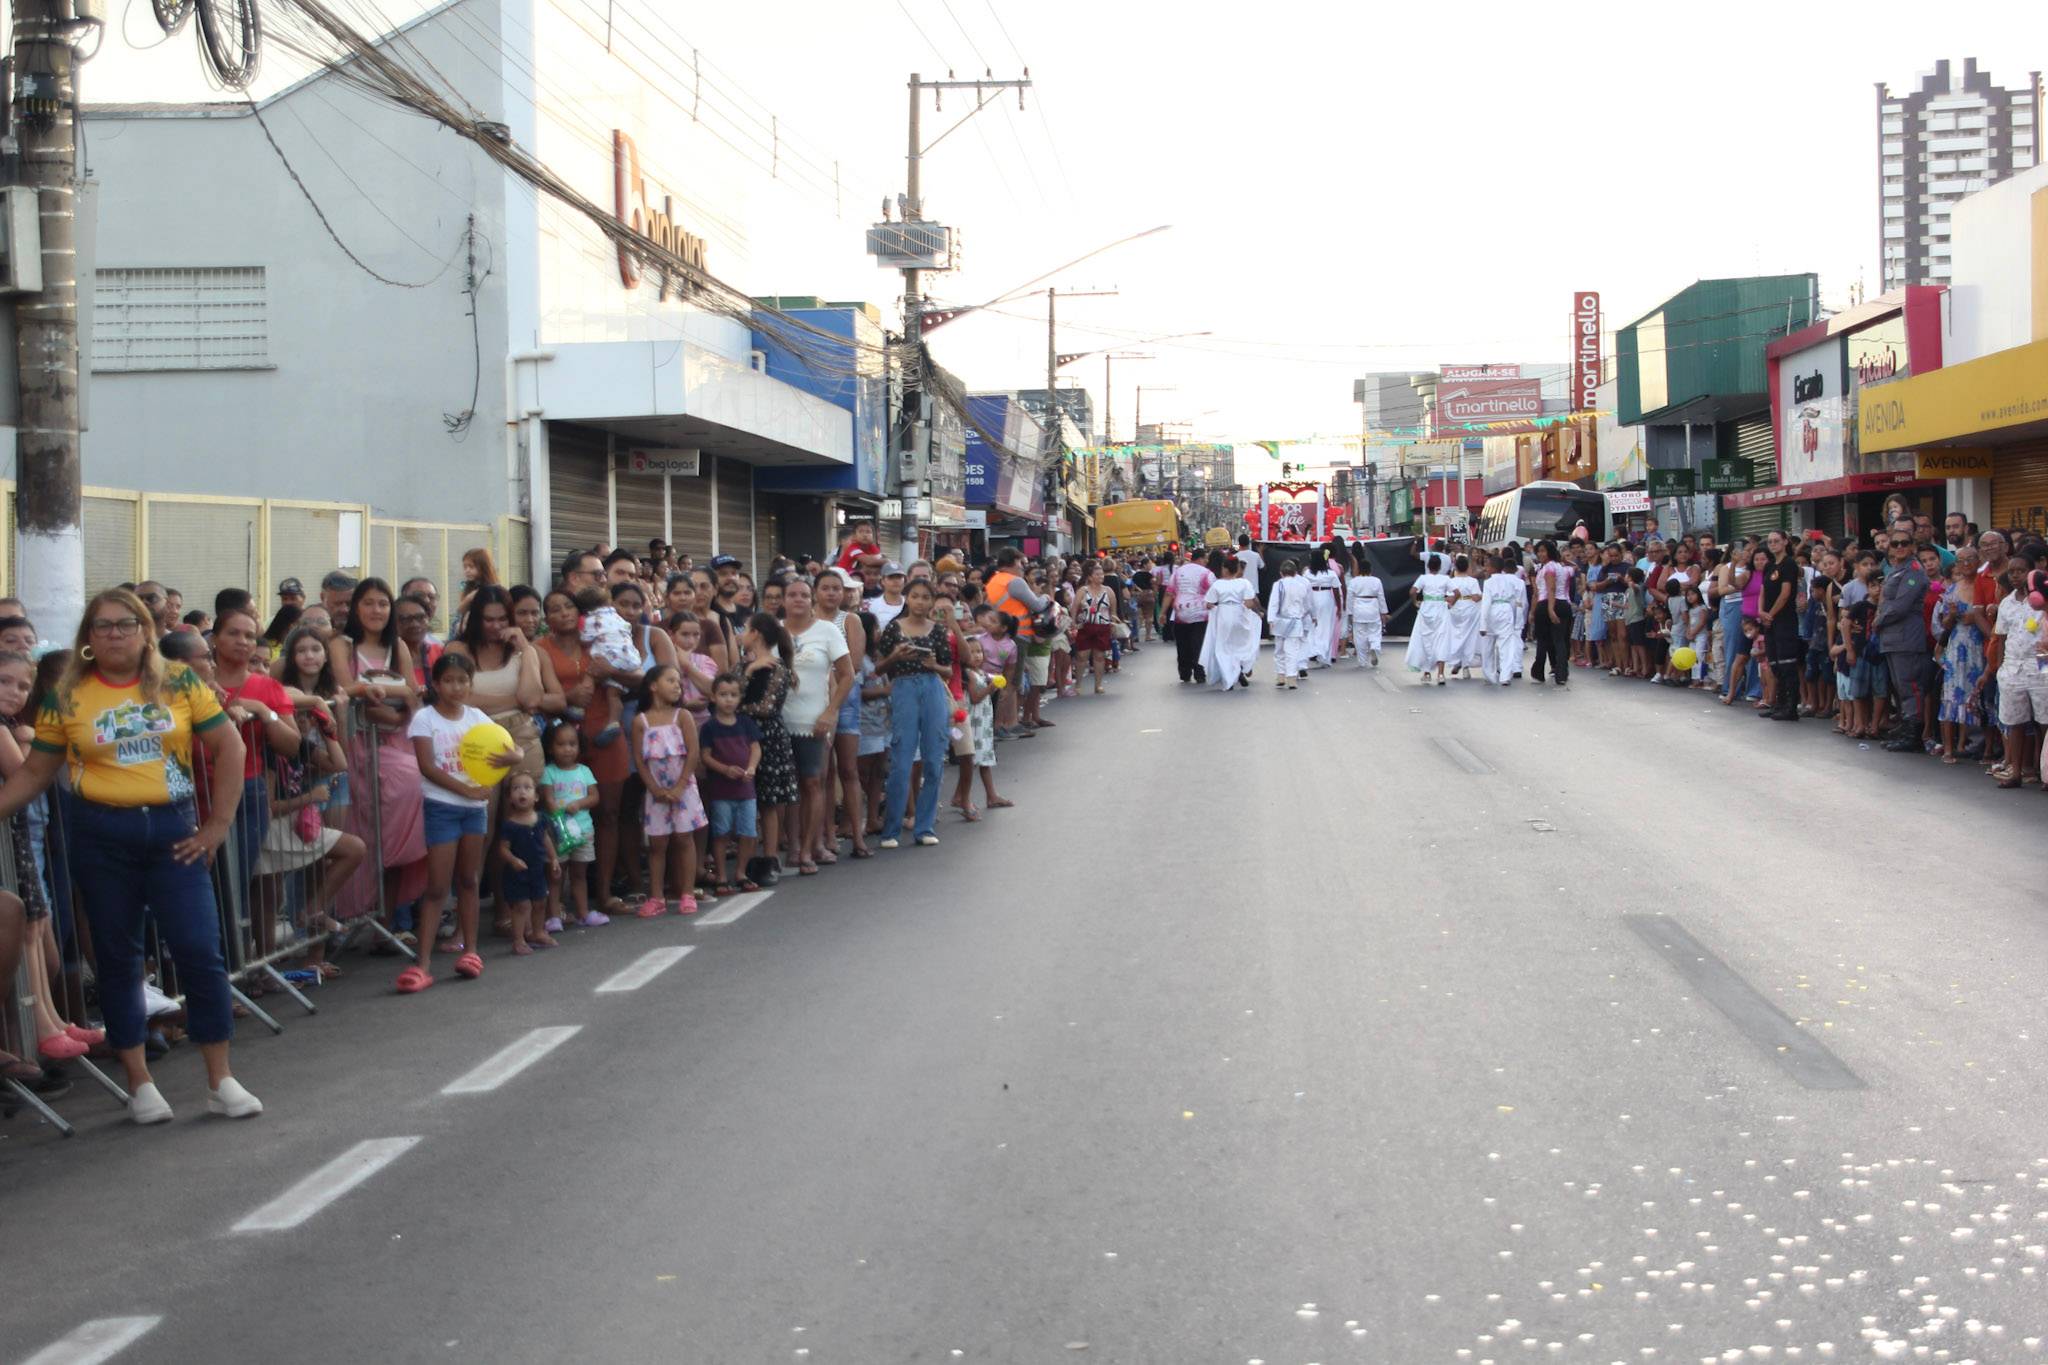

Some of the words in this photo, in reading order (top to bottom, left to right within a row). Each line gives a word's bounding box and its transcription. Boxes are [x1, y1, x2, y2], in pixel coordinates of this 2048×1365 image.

[1578, 295, 1597, 408] martinello
[1447, 368, 1517, 377] ALUGAM-SE
[1455, 399, 1538, 414] martinello
[1864, 400, 1907, 434] AVENIDA
[648, 459, 697, 473] biglojas
[1922, 456, 1988, 470] AVENIDA
[117, 735, 163, 758] ANOS
